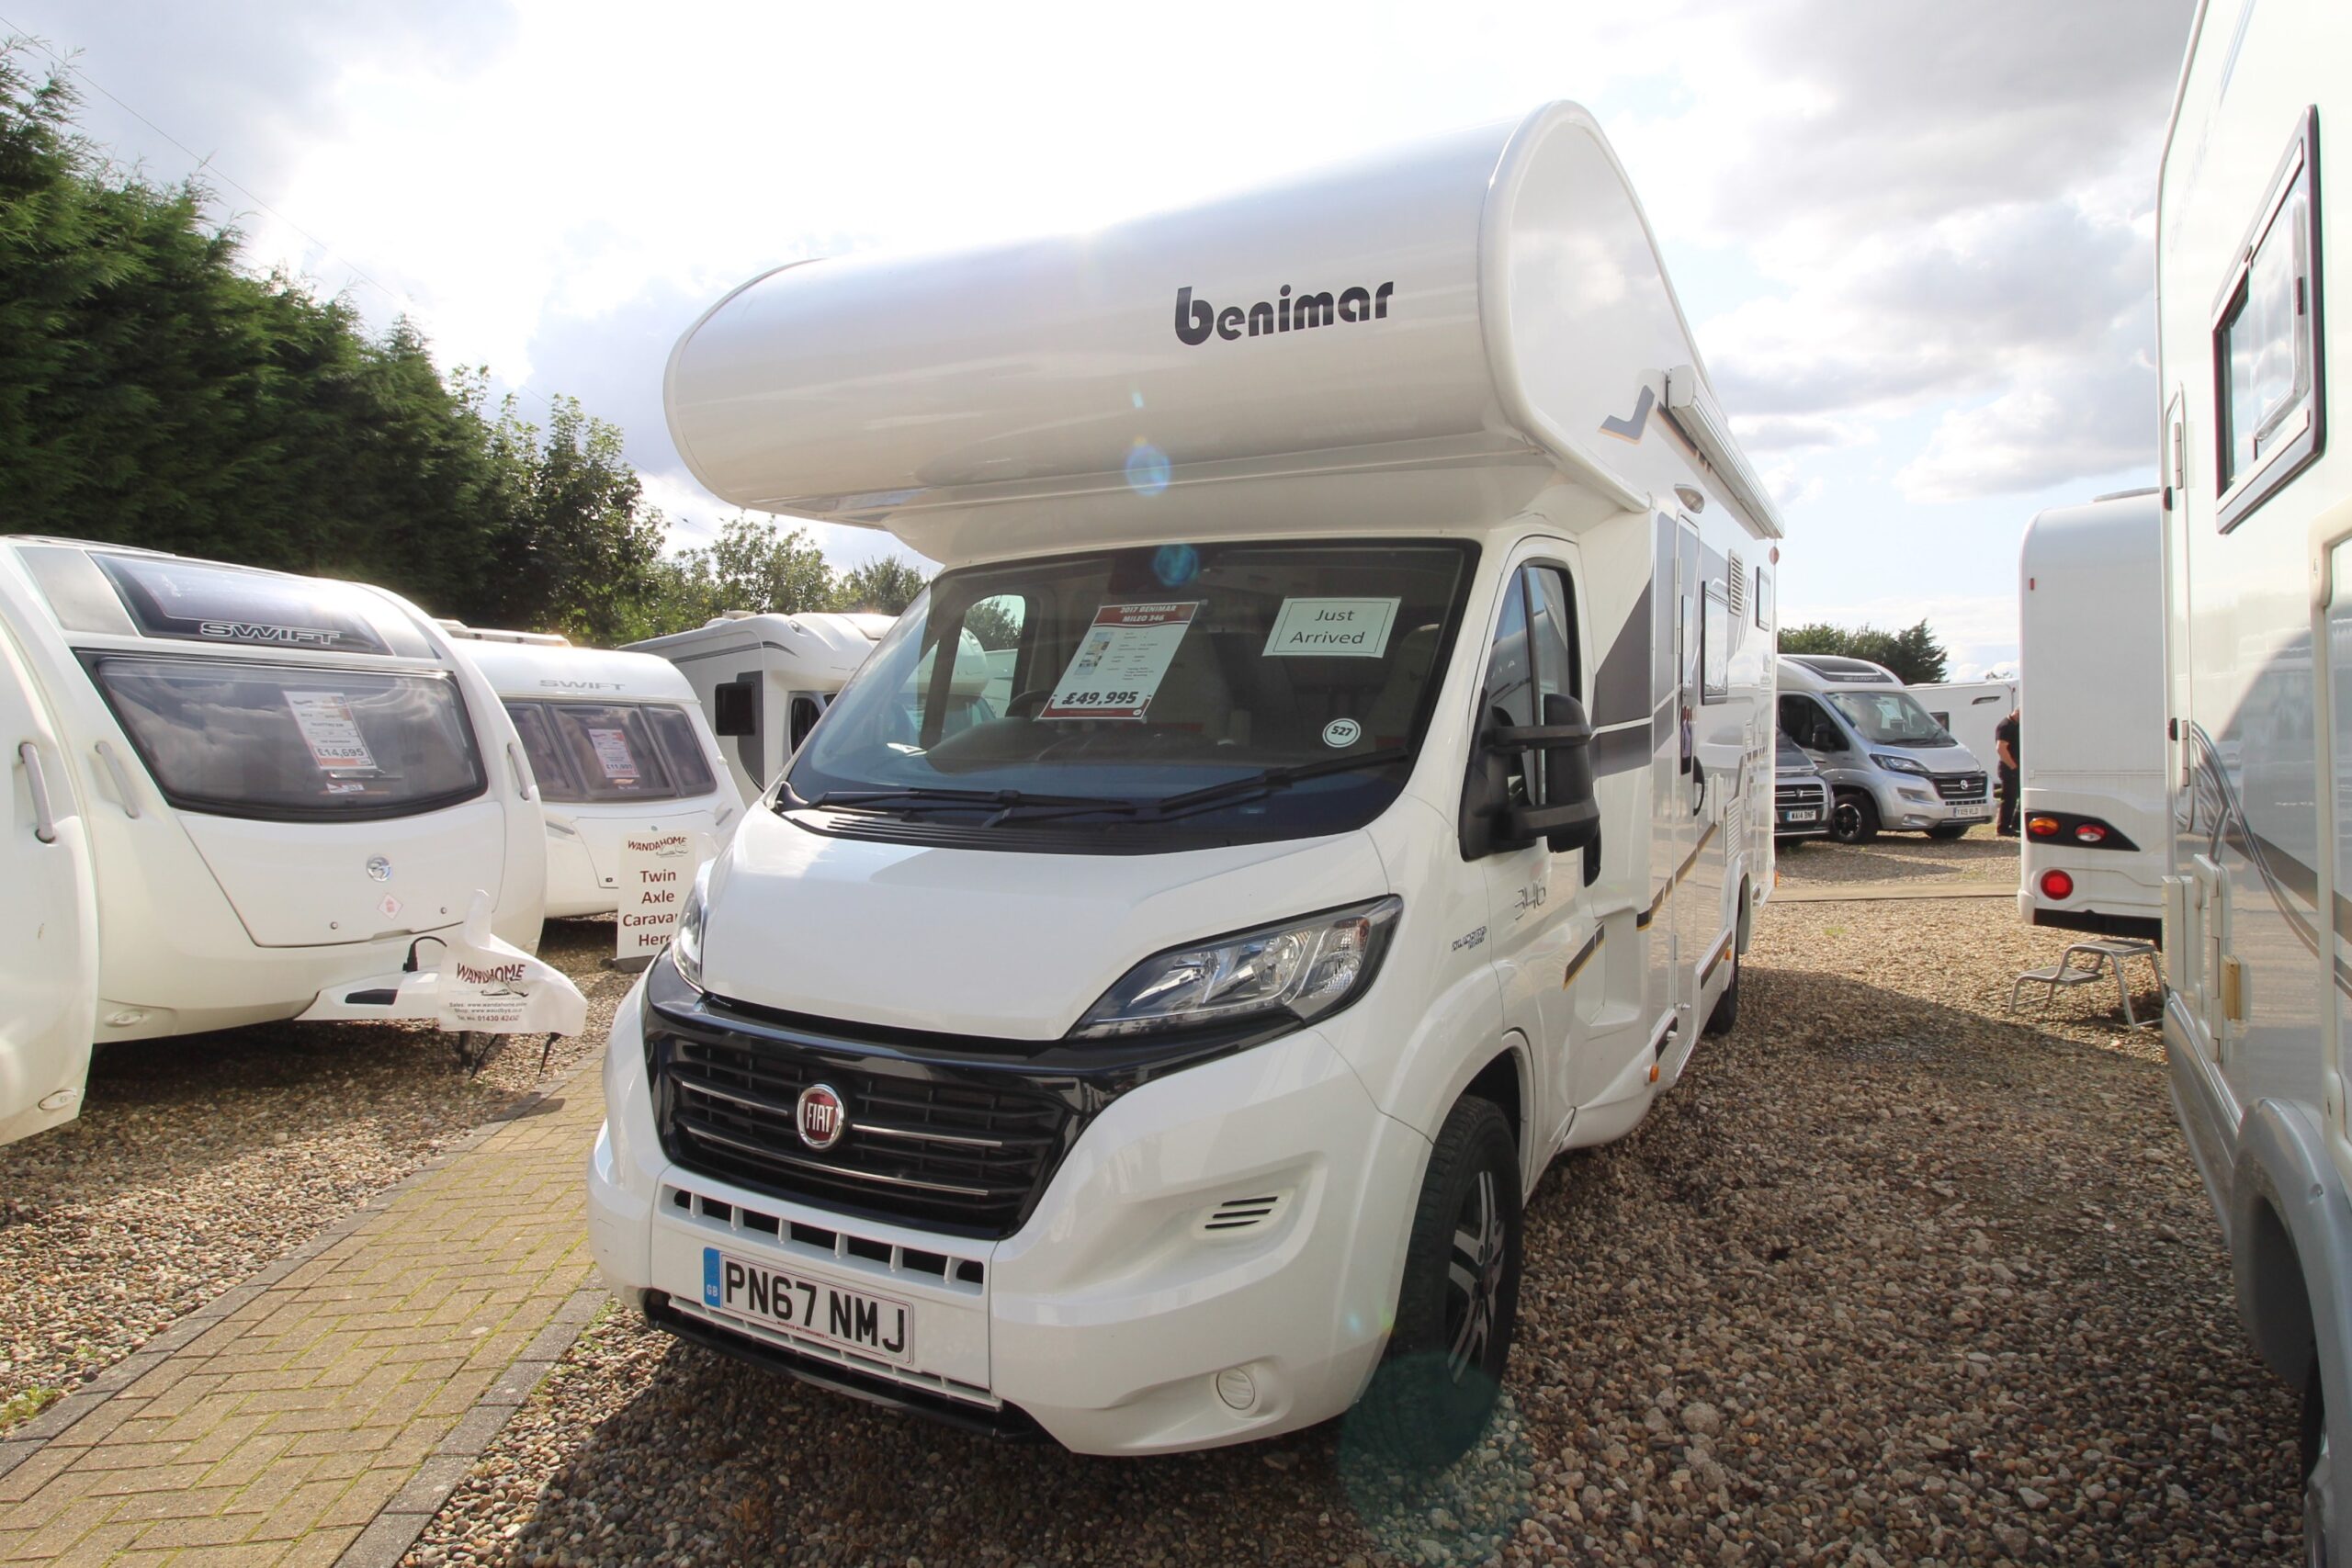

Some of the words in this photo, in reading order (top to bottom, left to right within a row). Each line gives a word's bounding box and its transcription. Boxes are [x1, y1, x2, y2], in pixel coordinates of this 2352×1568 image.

[1174, 280, 1395, 346] benimar
[1139, 604, 1177, 613] BENIMAR
[1315, 609, 1355, 622] Just
[200, 622, 341, 645] SWIFT
[1289, 631, 1366, 645] Arrived
[539, 680, 626, 691] SWIFT
[1061, 691, 1139, 706] £49,995
[1330, 725, 1353, 737] 527
[317, 748, 365, 758] £14,695
[628, 836, 688, 852] WANDAHOME
[639, 868, 677, 884] Twin
[641, 889, 675, 904] Axle
[622, 912, 678, 928] Carava
[806, 1102, 834, 1133] FIAT
[707, 1284, 718, 1297] GB
[725, 1260, 818, 1327] PN67
[829, 1289, 905, 1354] NMJ
